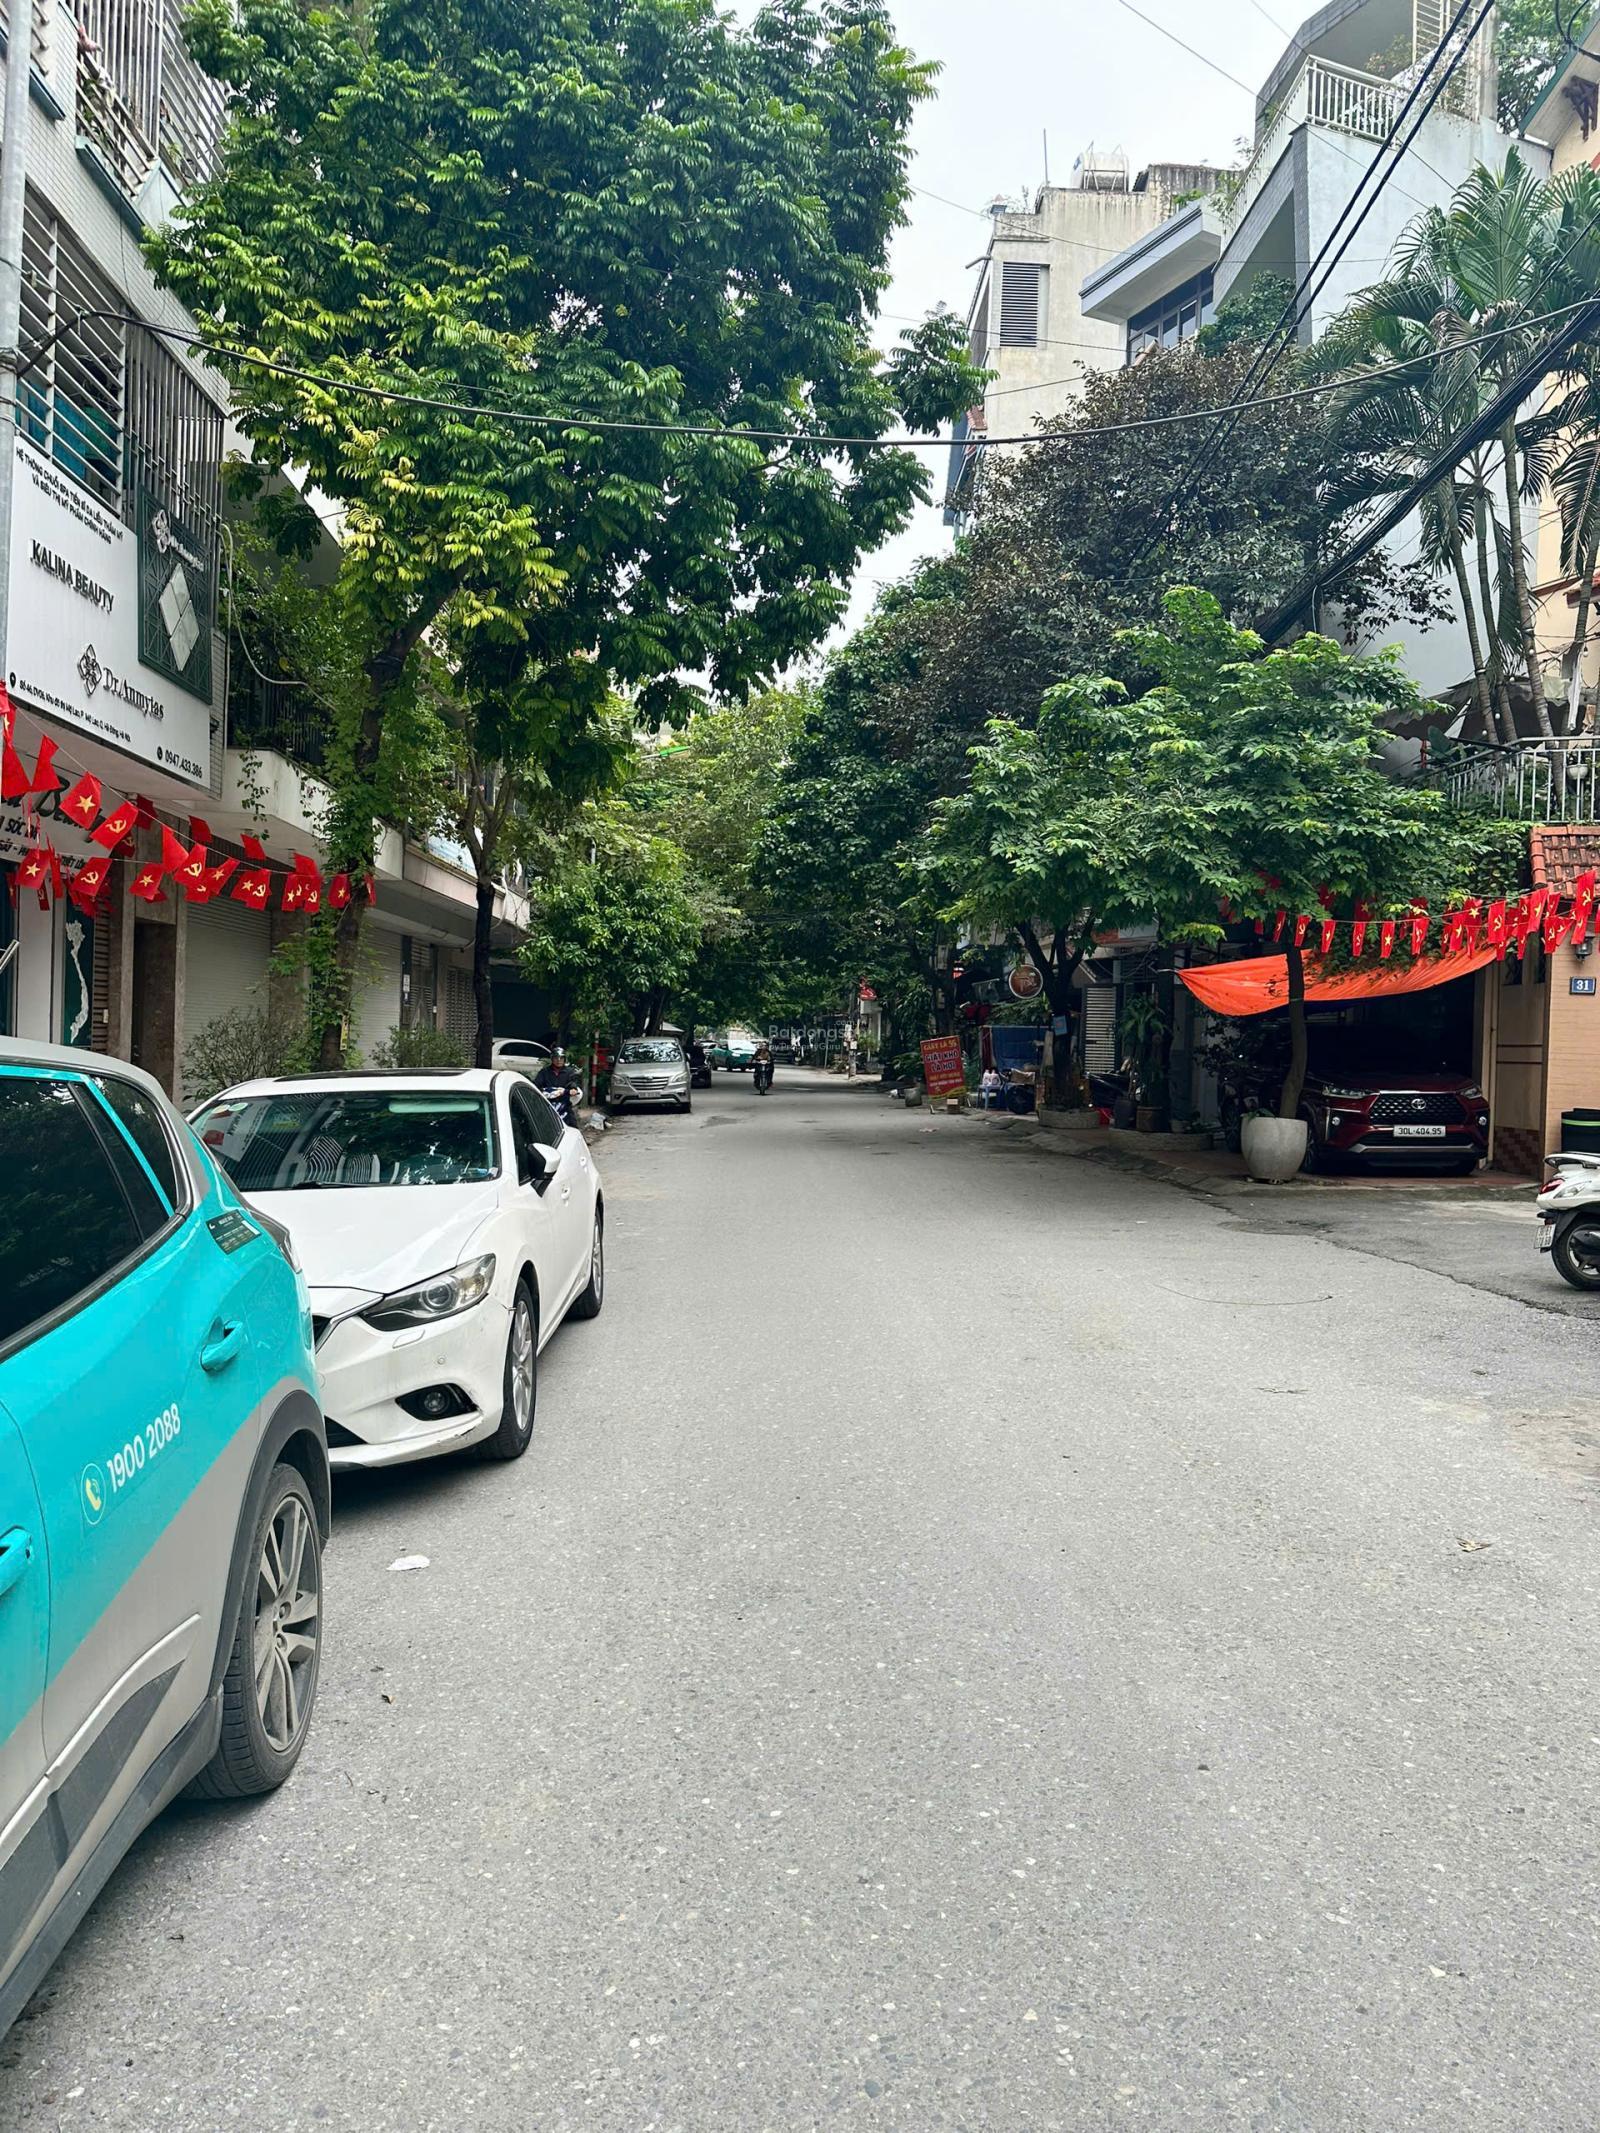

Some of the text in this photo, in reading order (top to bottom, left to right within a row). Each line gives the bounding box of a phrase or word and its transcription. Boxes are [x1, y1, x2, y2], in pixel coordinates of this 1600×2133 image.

[32, 539, 114, 612] KALINA BEAUTY
[1576, 980, 1588, 990] 31
[106, 1403, 180, 1493] 1900 2088
